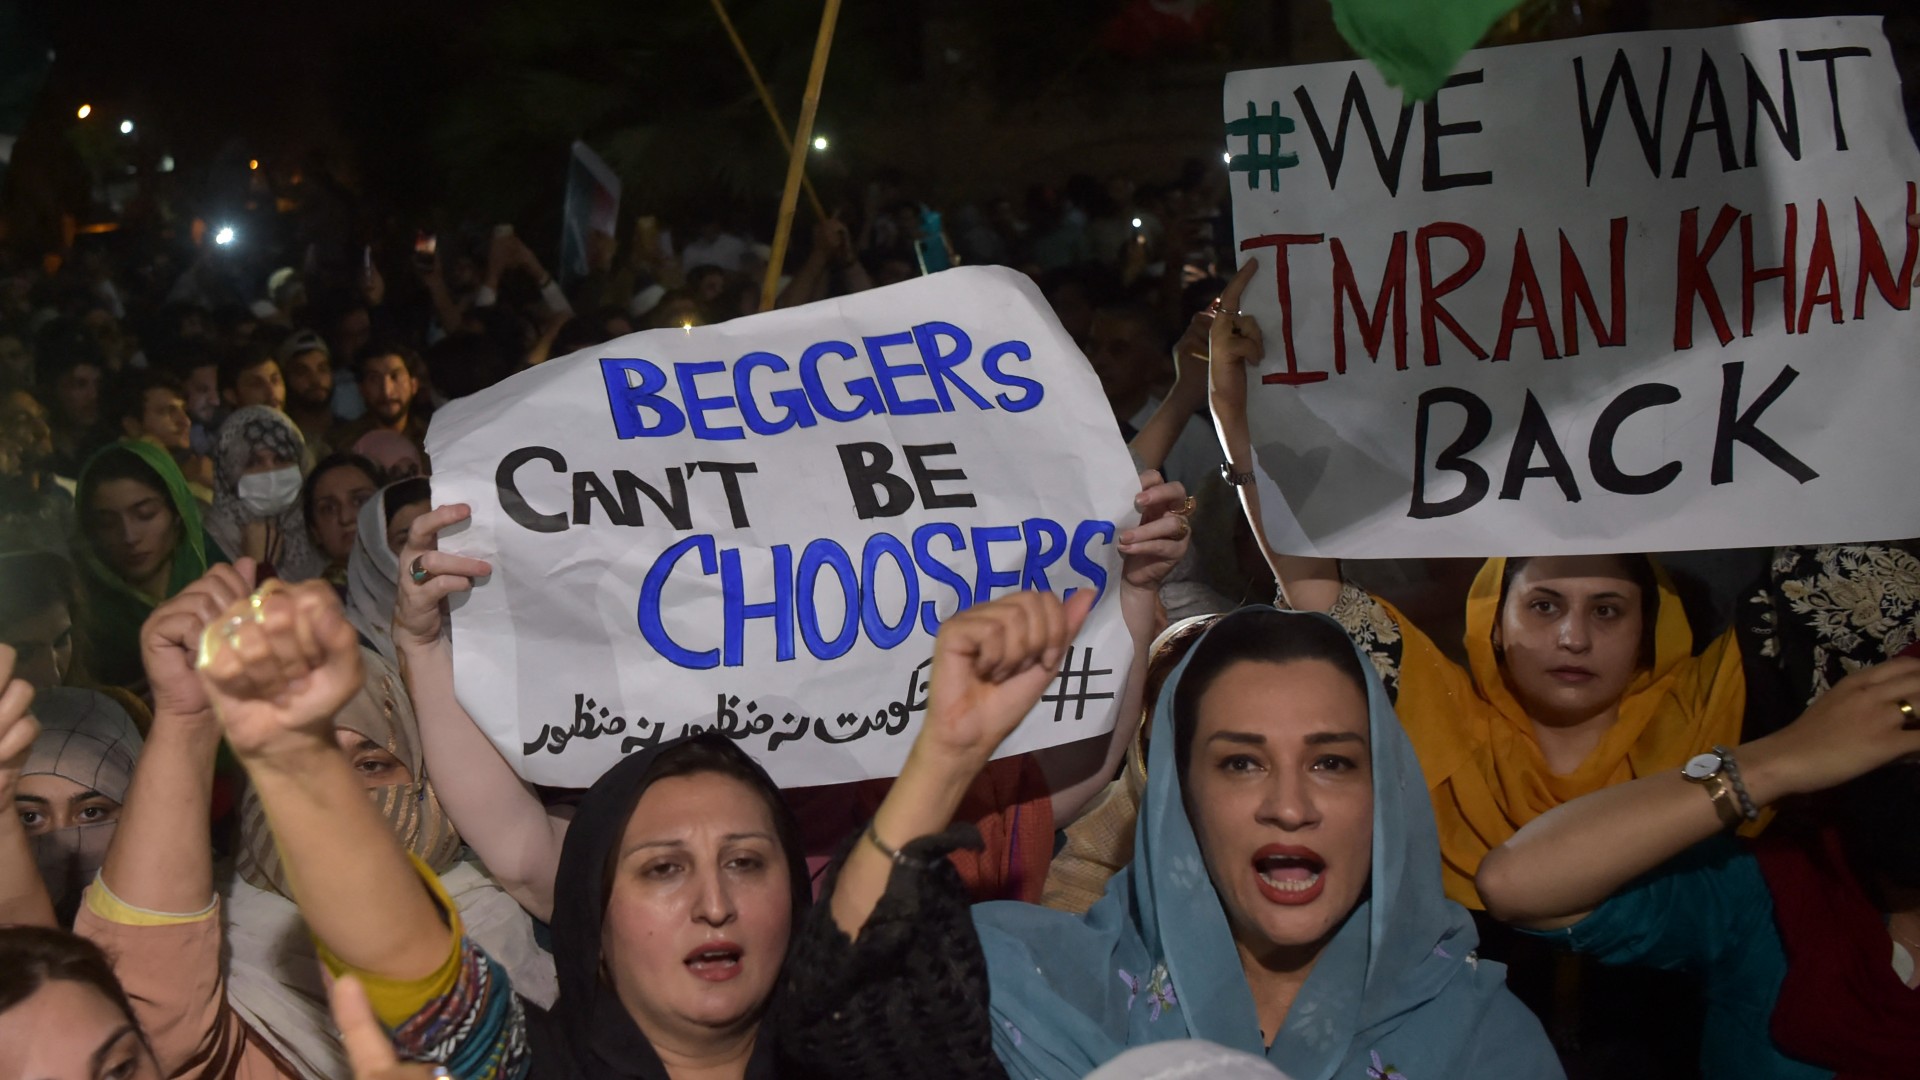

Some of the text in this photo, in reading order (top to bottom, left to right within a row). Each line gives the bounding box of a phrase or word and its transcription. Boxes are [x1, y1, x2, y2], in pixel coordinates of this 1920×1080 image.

[1573, 47, 1872, 188] WANT
[1240, 181, 1919, 385] IMRAN KHAN
[600, 321, 1045, 441] BEGGERS
[1406, 361, 1820, 519] BACK
[495, 441, 977, 532] CAN'T BE
[637, 518, 1116, 670] CHOOSERS
[523, 693, 627, 756] منظور
